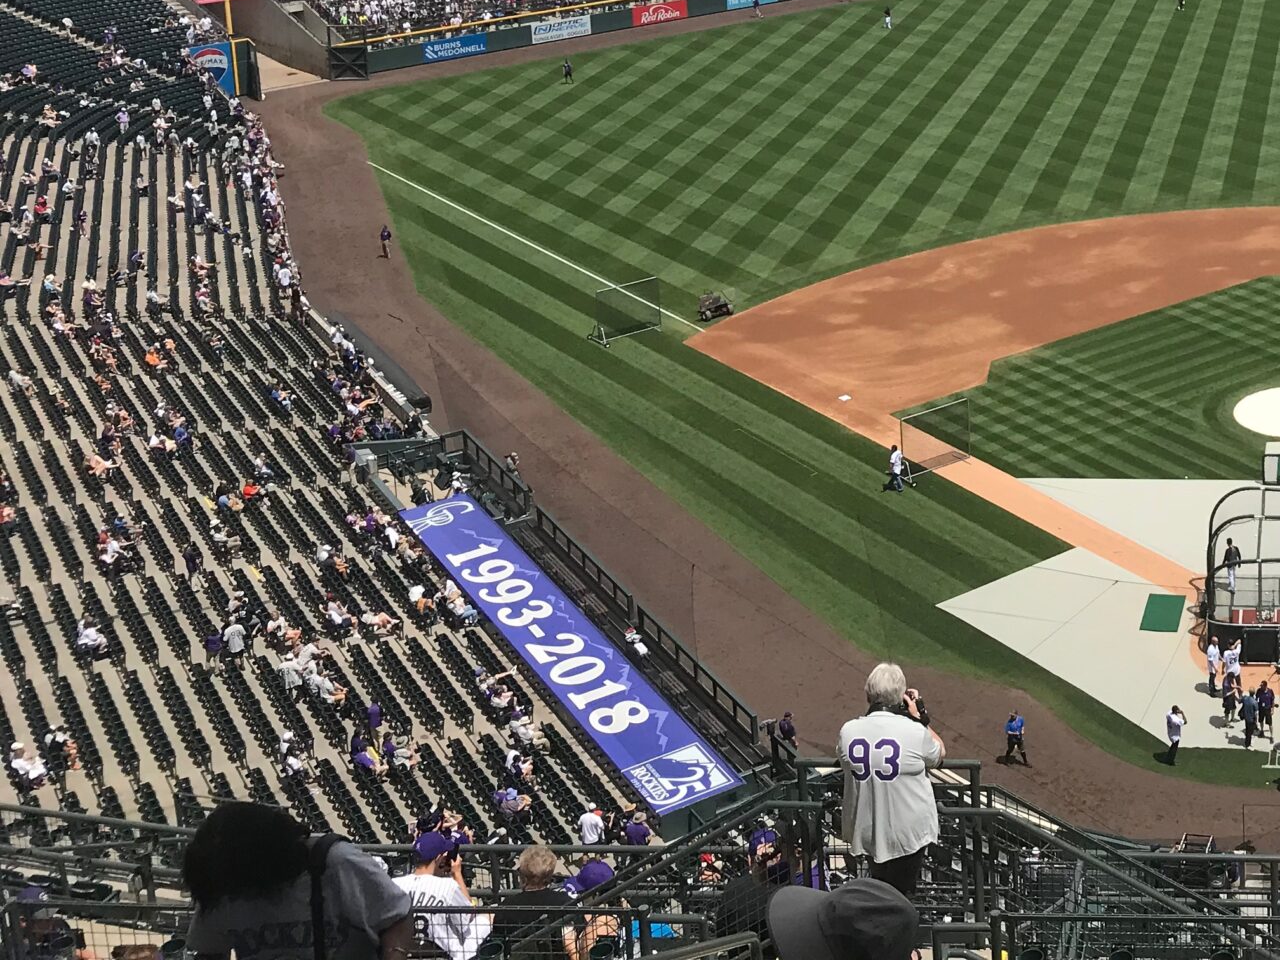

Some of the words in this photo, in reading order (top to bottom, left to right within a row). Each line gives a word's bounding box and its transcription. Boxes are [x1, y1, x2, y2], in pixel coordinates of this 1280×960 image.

[550, 23, 588, 33] NERVE
[552, 18, 583, 28] OPTIC
[641, 11, 657, 24] Red
[658, 9, 680, 19] Robin
[434, 40, 461, 51] BURNS
[408, 501, 475, 538] CR
[446, 543, 649, 734] 1993-2018
[847, 737, 902, 782] 93
[630, 765, 669, 801] ROCKIES
[647, 766, 706, 805] 25
